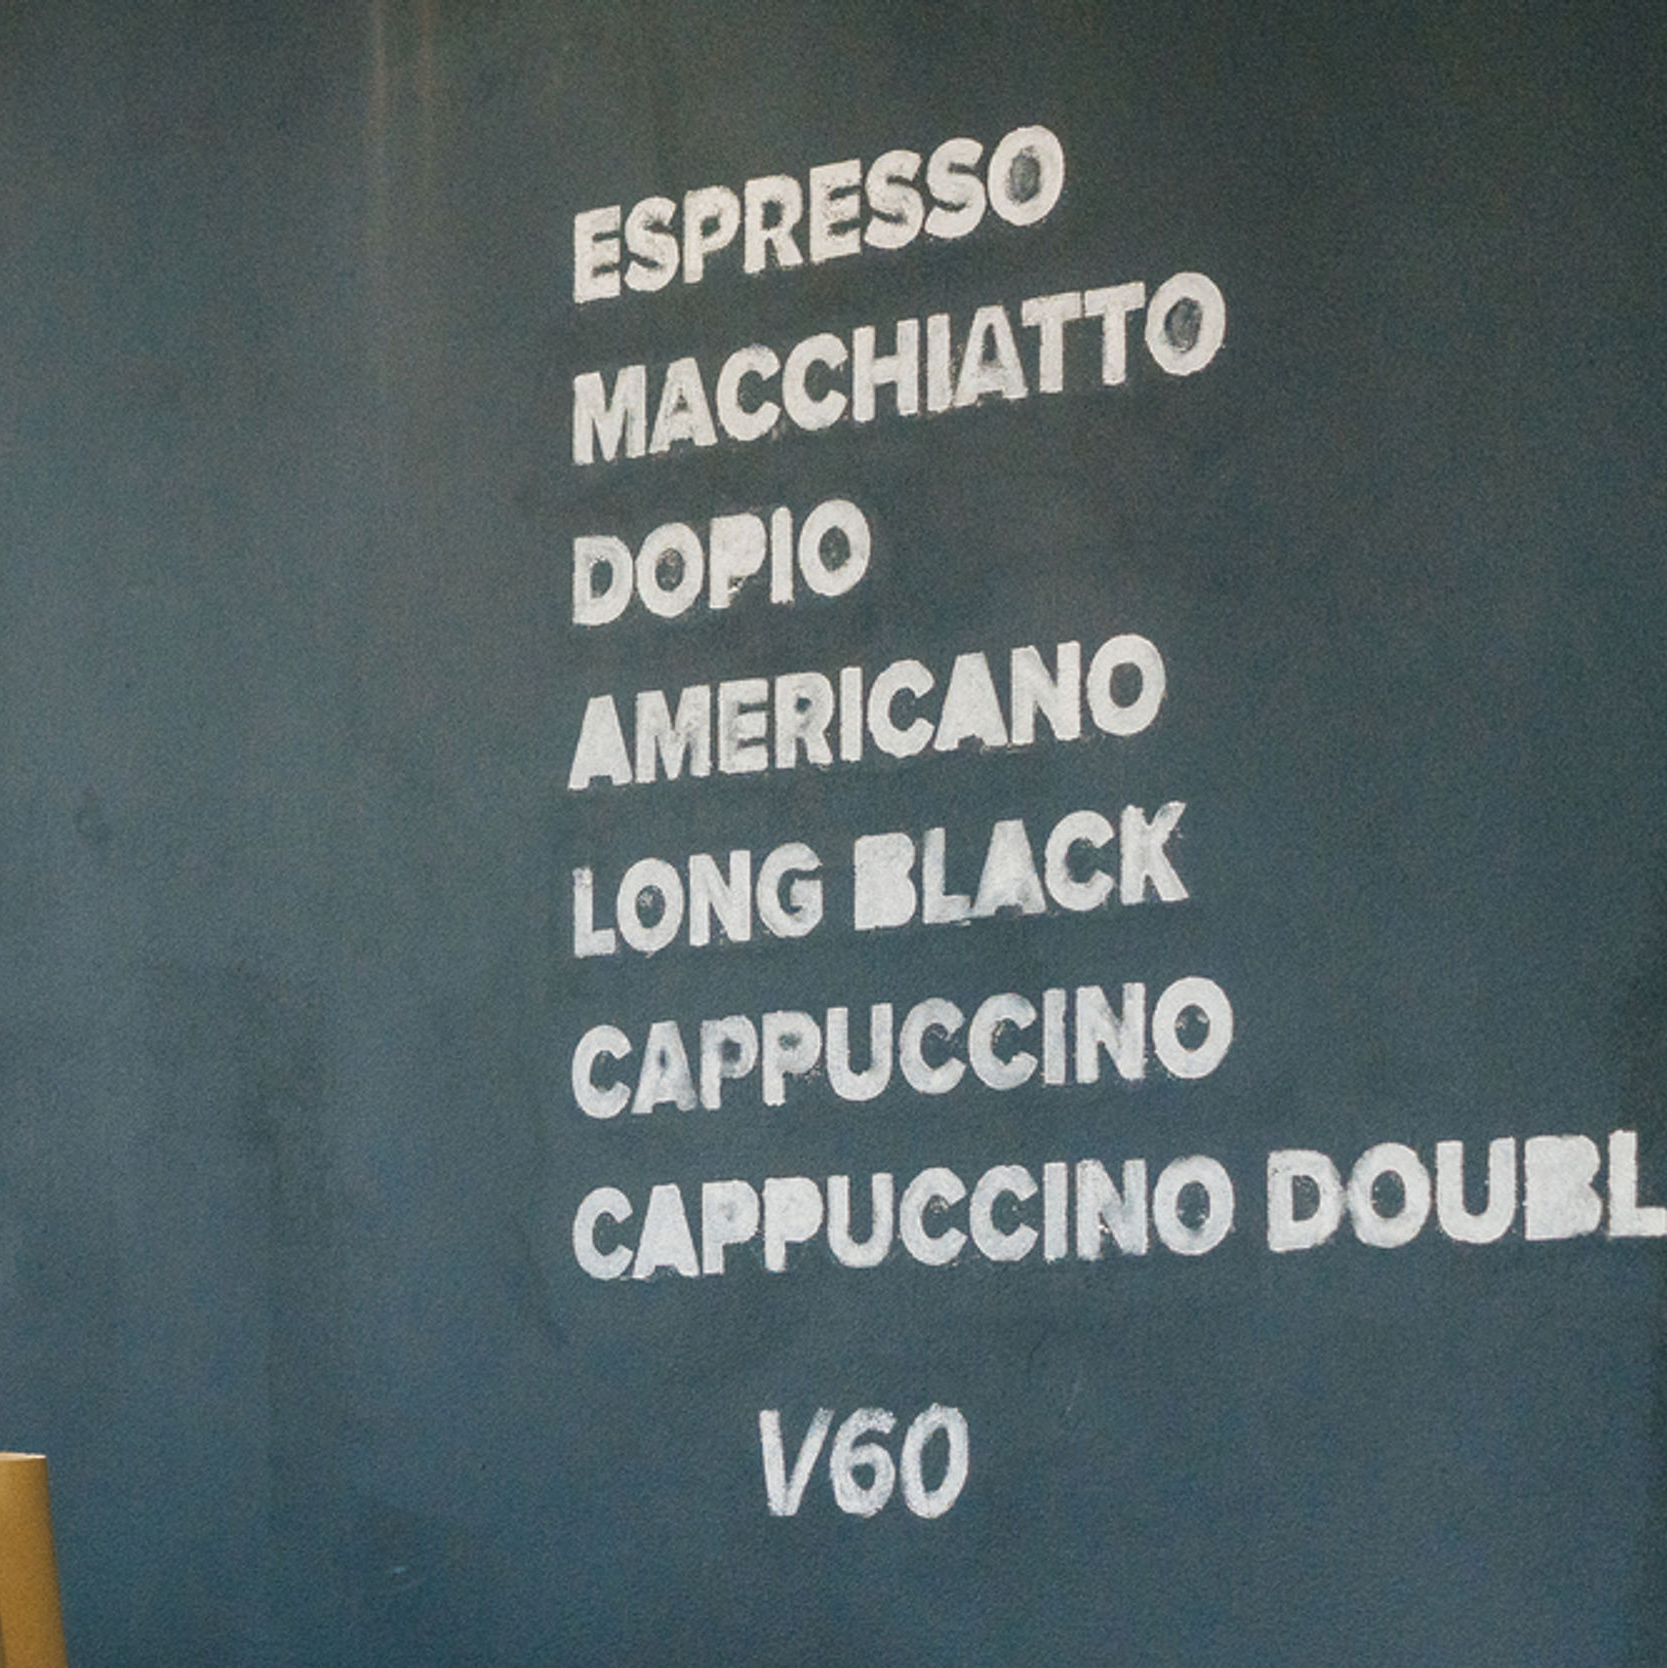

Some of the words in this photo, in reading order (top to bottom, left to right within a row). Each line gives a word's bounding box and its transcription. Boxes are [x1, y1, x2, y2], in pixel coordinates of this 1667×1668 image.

[572, 124, 1066, 305] ESPRESSO
[572, 271, 1226, 466] MACCHIATTO
[571, 498, 872, 627] DOPIO
[567, 633, 1167, 791] AMERICANO
[572, 842, 824, 959] LONG
[853, 800, 1190, 931] BLACK
[571, 975, 1234, 1119] CAPPUCCINO
[571, 1154, 1236, 1281] CAPPUCCINO
[1266, 1129, 1667, 1254] DOUBL
[758, 1402, 970, 1519] V60
